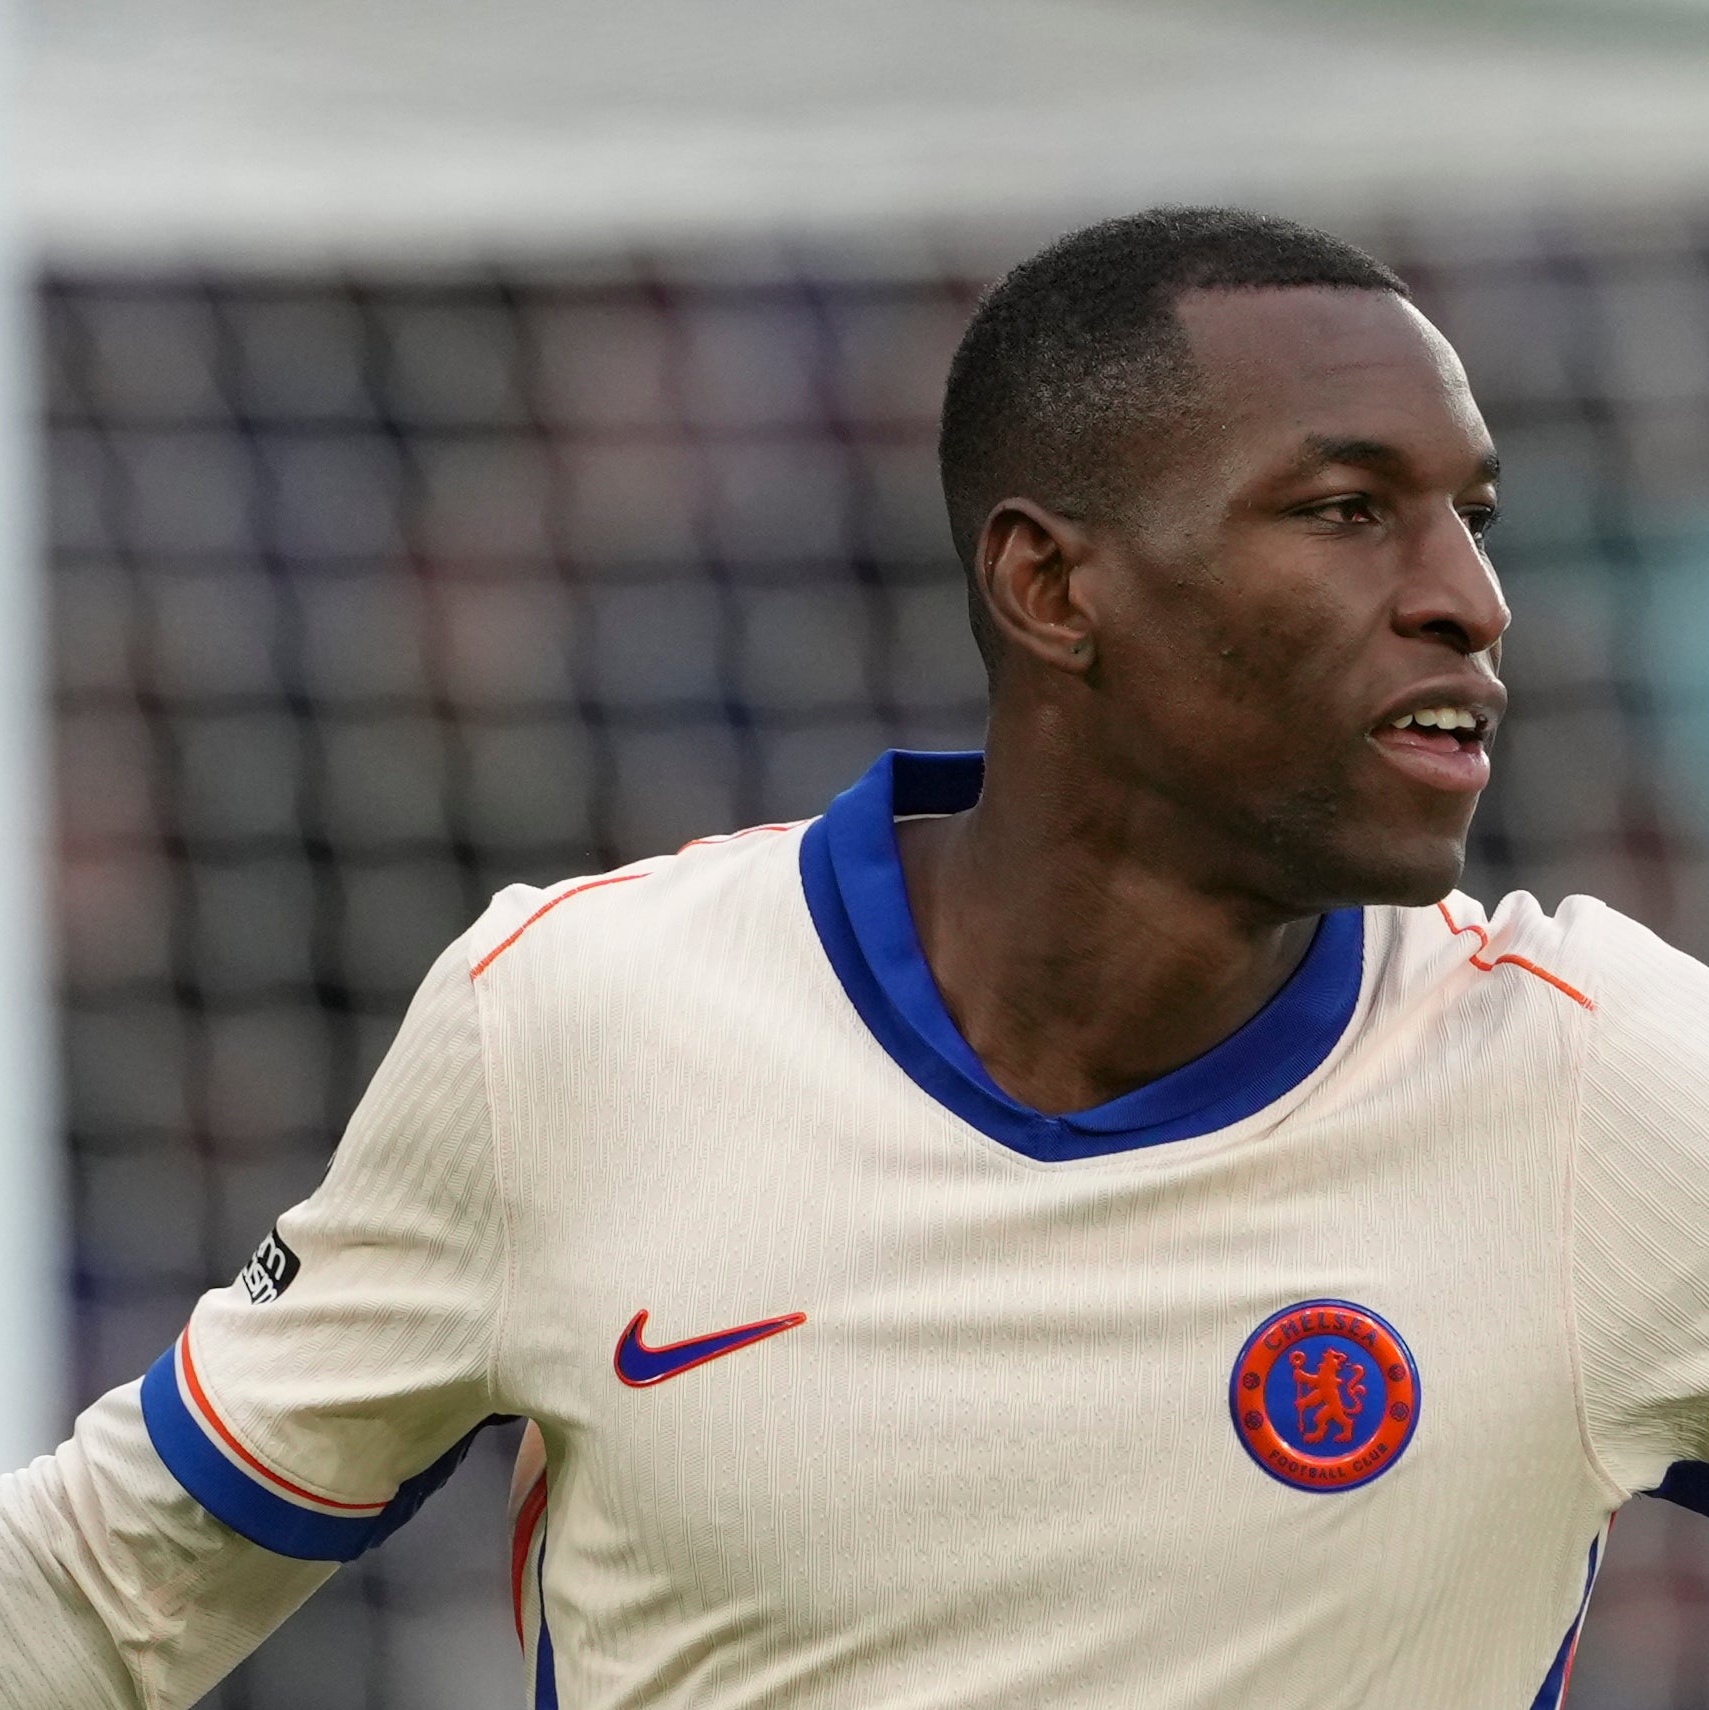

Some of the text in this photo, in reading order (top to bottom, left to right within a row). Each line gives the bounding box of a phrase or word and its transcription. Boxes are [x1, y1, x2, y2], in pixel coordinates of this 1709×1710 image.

[1263, 1311, 1379, 1351] CHELSEA
[1268, 1442, 1389, 1480] FOOTBALL CLUB
